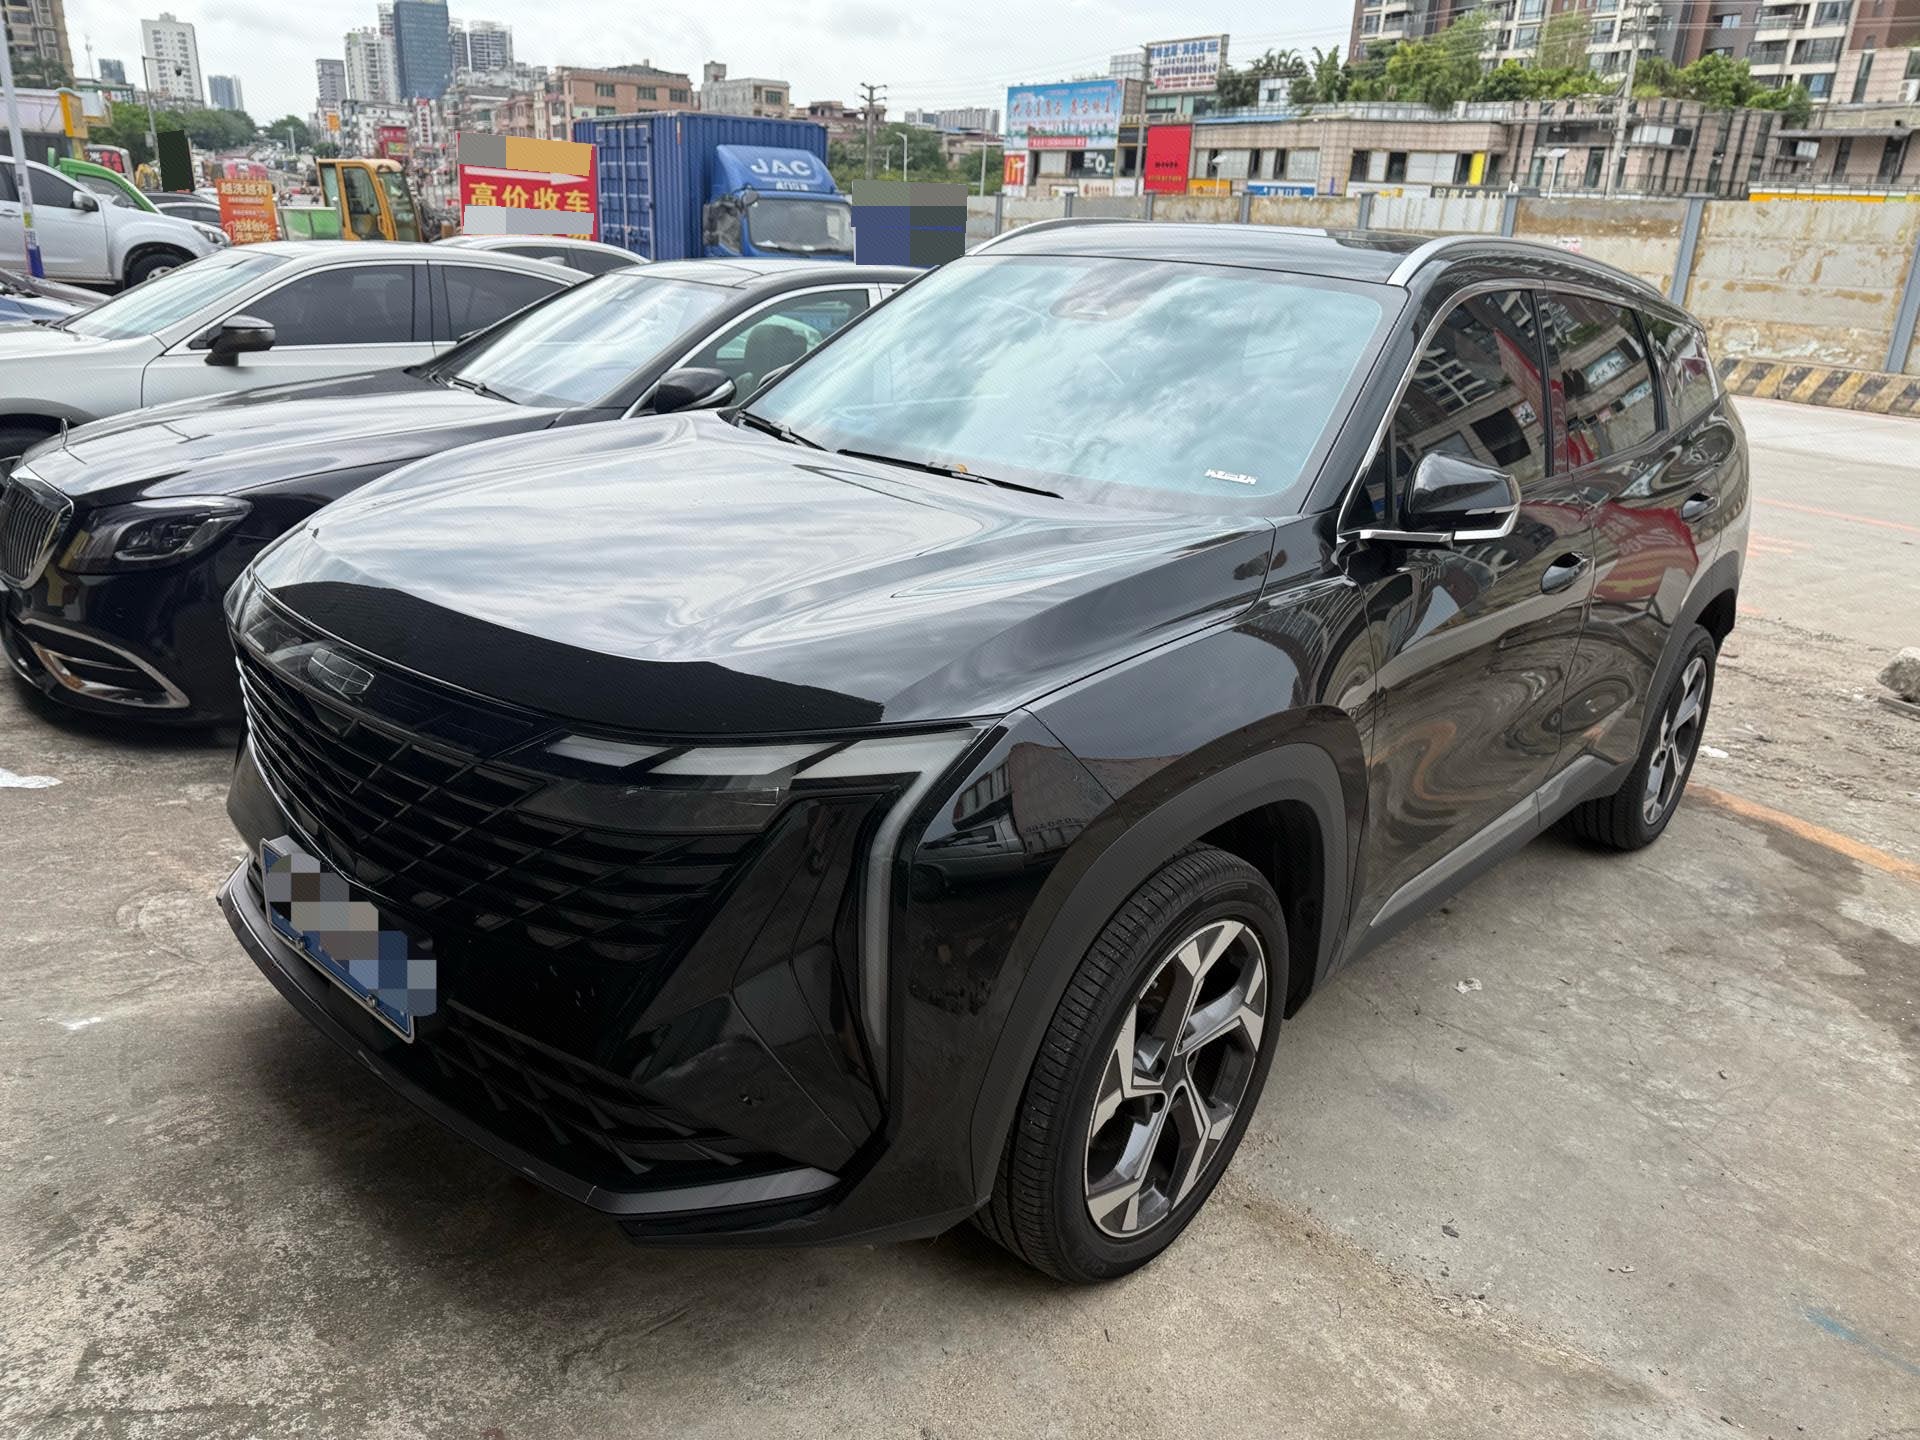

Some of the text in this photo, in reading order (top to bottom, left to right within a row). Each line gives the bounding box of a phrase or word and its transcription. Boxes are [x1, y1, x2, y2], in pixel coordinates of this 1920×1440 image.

[750, 158, 811, 176] JAC
[468, 182, 591, 213] 高价收车
